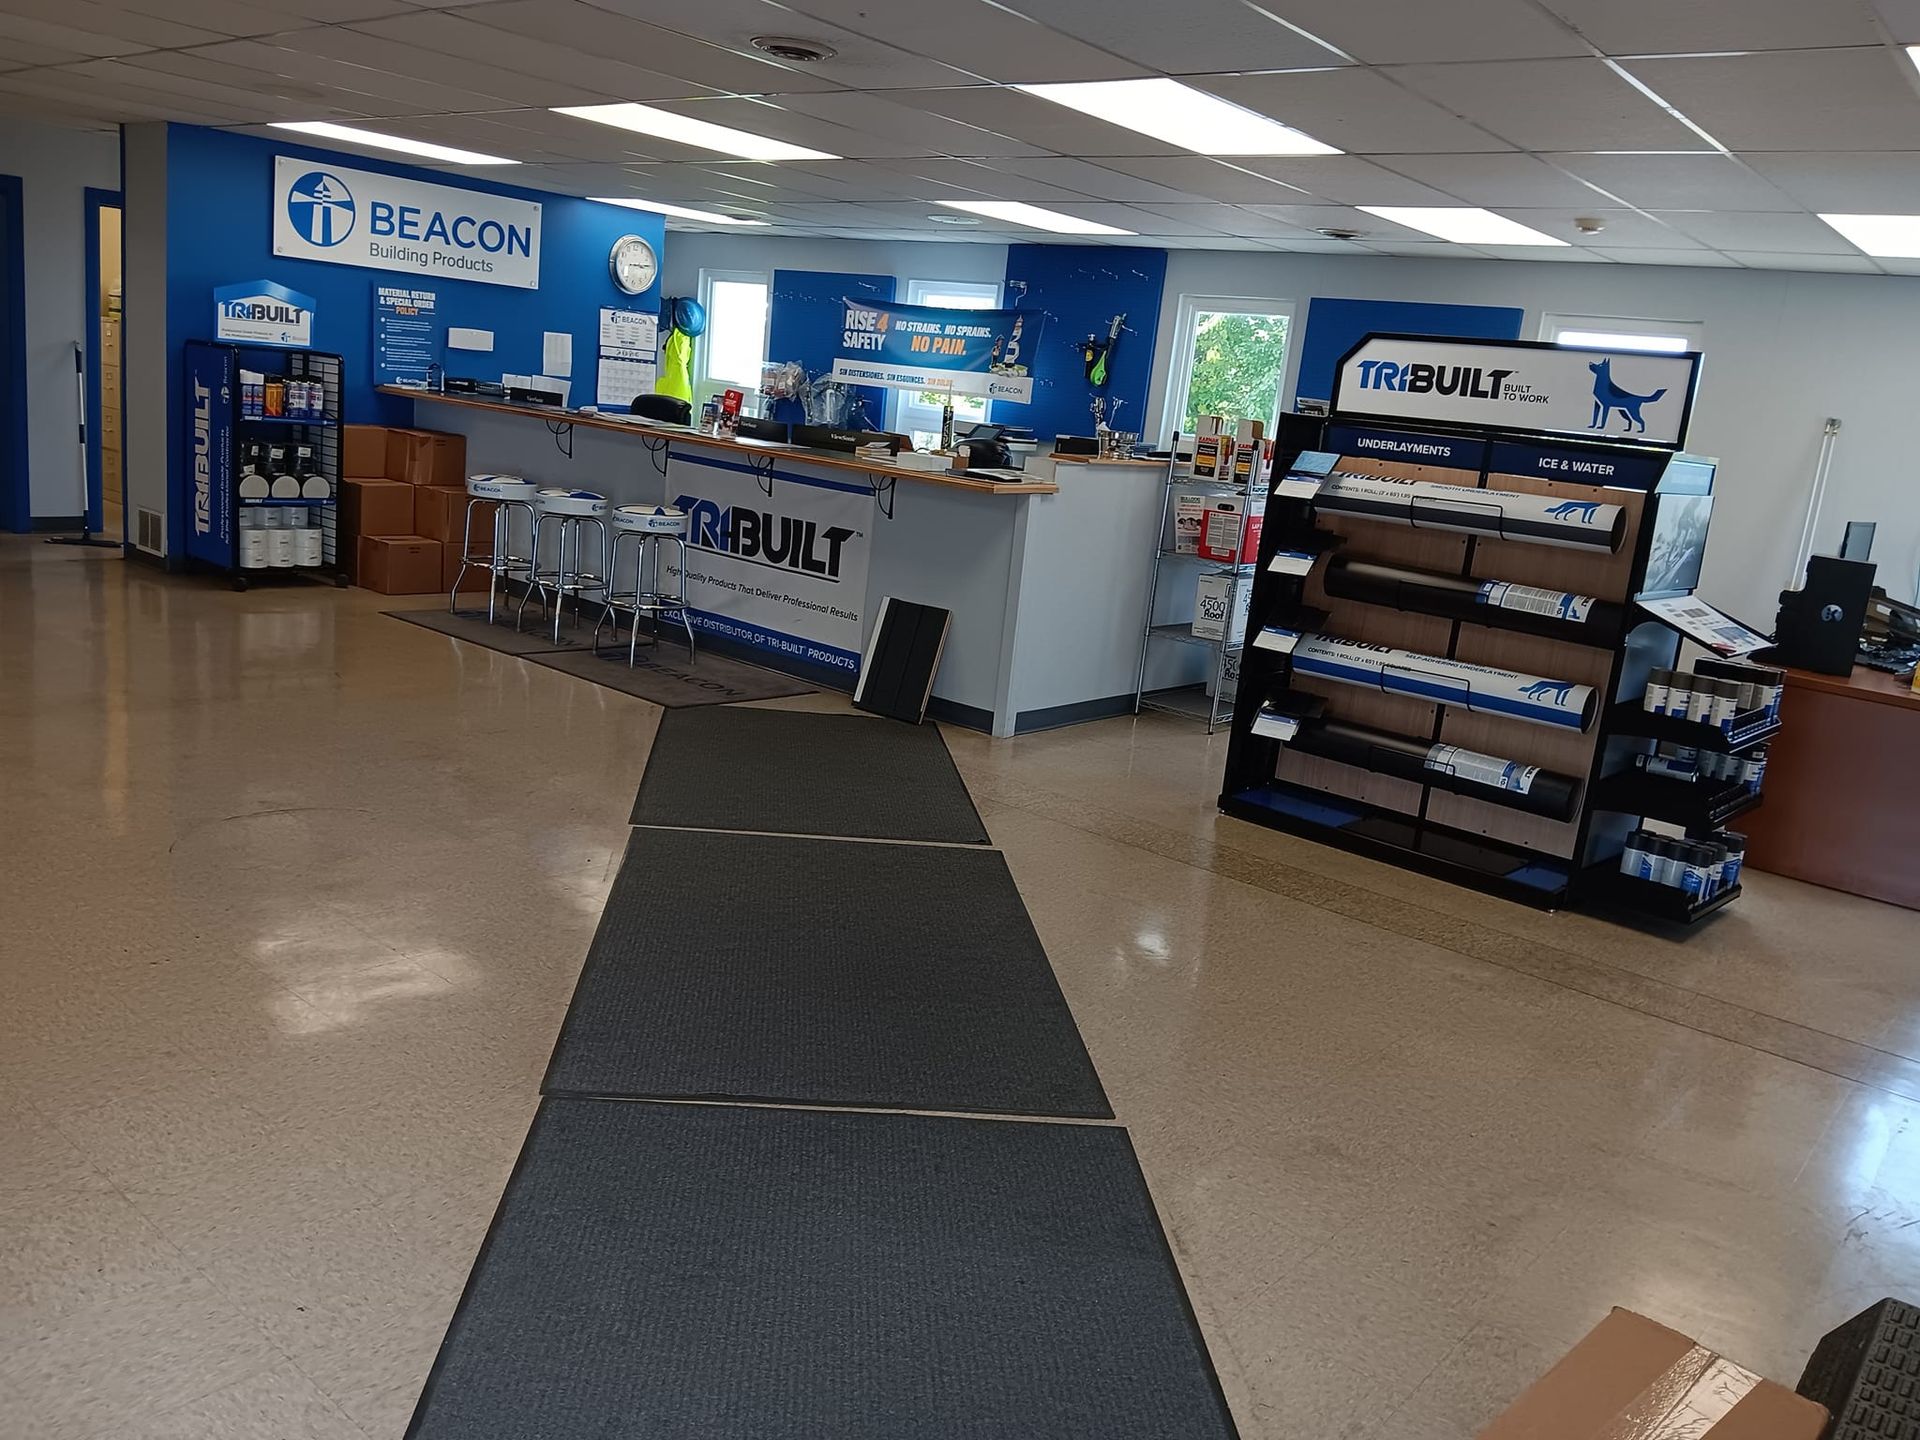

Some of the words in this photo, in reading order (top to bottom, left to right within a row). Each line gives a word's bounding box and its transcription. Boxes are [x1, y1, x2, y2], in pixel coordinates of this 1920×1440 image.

[370, 201, 531, 258] BEACON
[369, 243, 428, 271] Building
[433, 253, 493, 278] Products
[378, 287, 411, 299] MATERIAL
[411, 290, 436, 301] RETURN
[380, 296, 386, 305] &
[386, 297, 413, 307] SPECIAL
[413, 299, 435, 309] ORDER
[395, 306, 419, 316] POLICY
[622, 316, 648, 325] BEACON
[845, 309, 876, 332] RISE
[876, 313, 890, 334] 4
[895, 320, 907, 331] NO
[906, 321, 942, 335] STRAINS.
[944, 325, 956, 336] NO
[956, 326, 992, 338] SPRAINS.
[843, 331, 886, 352] SAFETY
[910, 335, 928, 353] NO
[932, 337, 967, 356] PAIN.
[839, 368, 848, 376] SIN
[887, 373, 896, 381] SIN
[998, 385, 1023, 395] BEACON
[1504, 383, 1532, 393] BUILT
[1503, 393, 1516, 402] TO
[1518, 394, 1549, 405] WORK
[829, 432, 856, 443] ViewSonic
[1357, 439, 1451, 458] UNDERLAYMENTS
[1538, 457, 1558, 469] ICE
[1560, 460, 1568, 471] &
[1572, 460, 1615, 477] WATER
[666, 564, 682, 578] High
[708, 575, 737, 592] Products
[738, 583, 755, 596] That
[755, 587, 782, 604] Deliver
[783, 594, 829, 614] Professional
[829, 606, 859, 622] Results
[1200, 599, 1226, 613] 4500
[1203, 608, 1225, 620] Roof
[703, 620, 753, 642] DISTRIBUTOR
[754, 633, 766, 645] OF
[1405, 653, 1459, 669] SELF-ADHERING
[1459, 664, 1519, 681] UNDERLAYMENT
